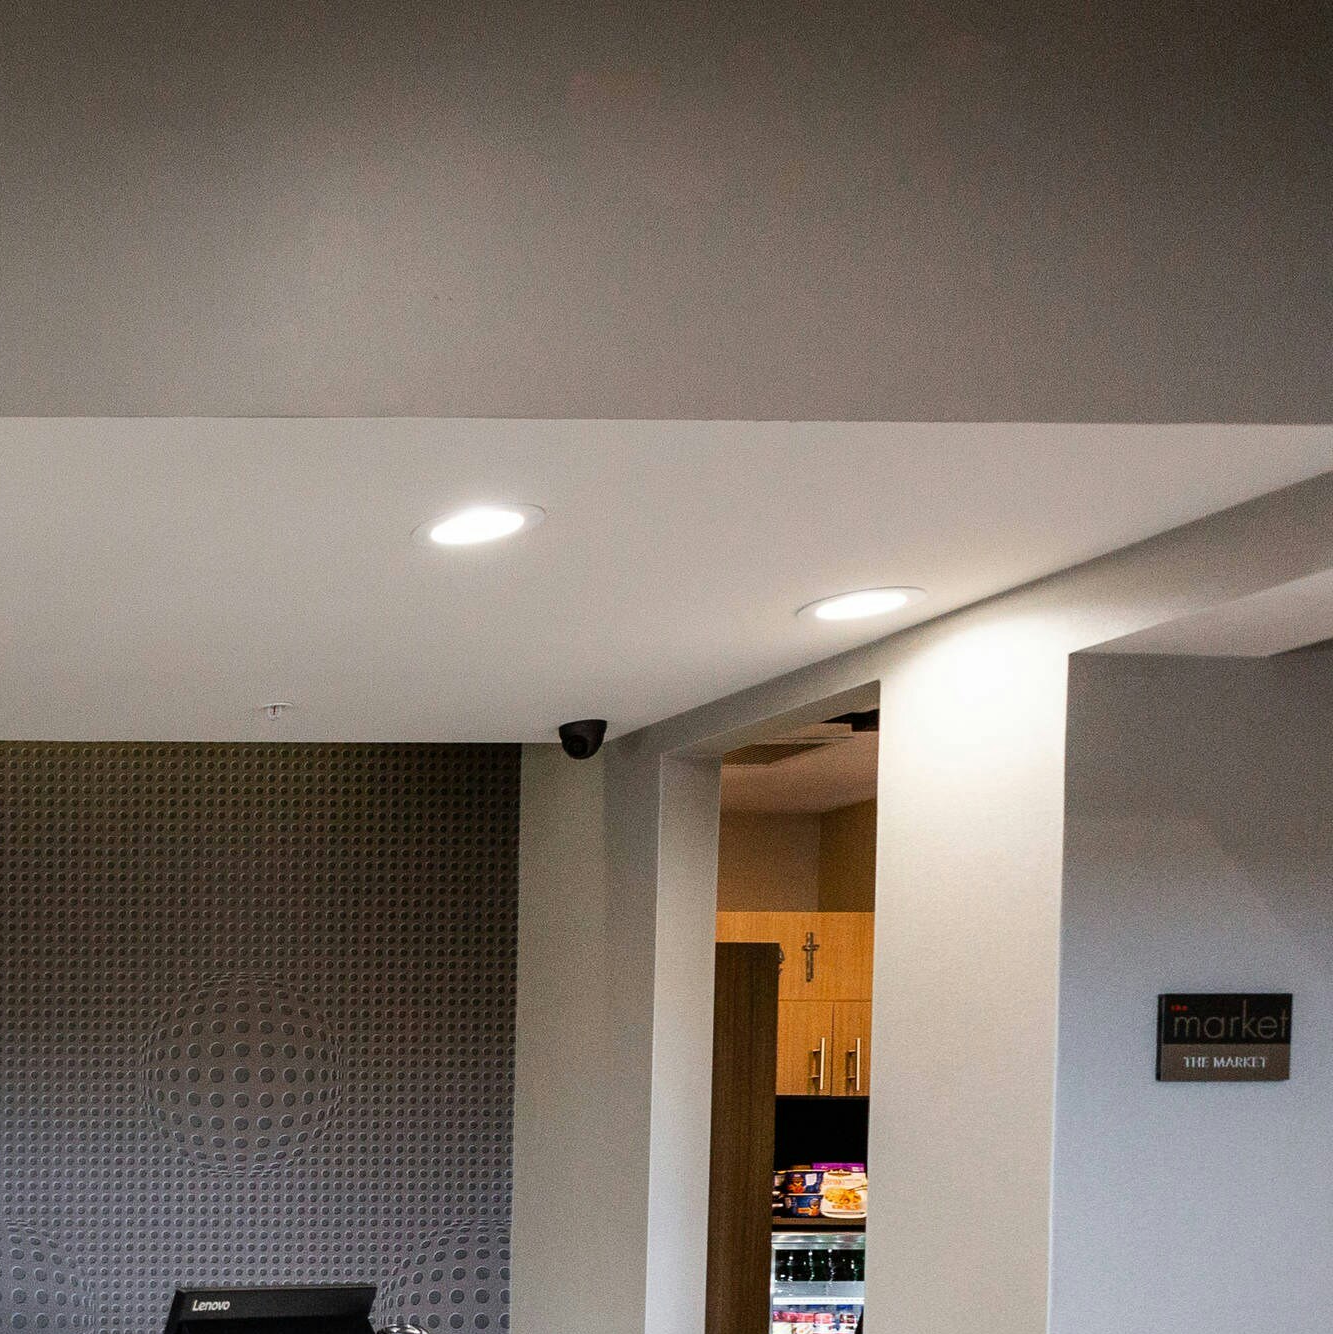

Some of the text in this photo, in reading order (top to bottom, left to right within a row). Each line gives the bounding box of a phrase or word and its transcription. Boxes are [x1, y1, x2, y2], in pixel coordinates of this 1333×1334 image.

[1173, 999, 1289, 1039] market
[1183, 1056, 1267, 1068] THE MARKET
[192, 1300, 231, 1311] Lenovo
